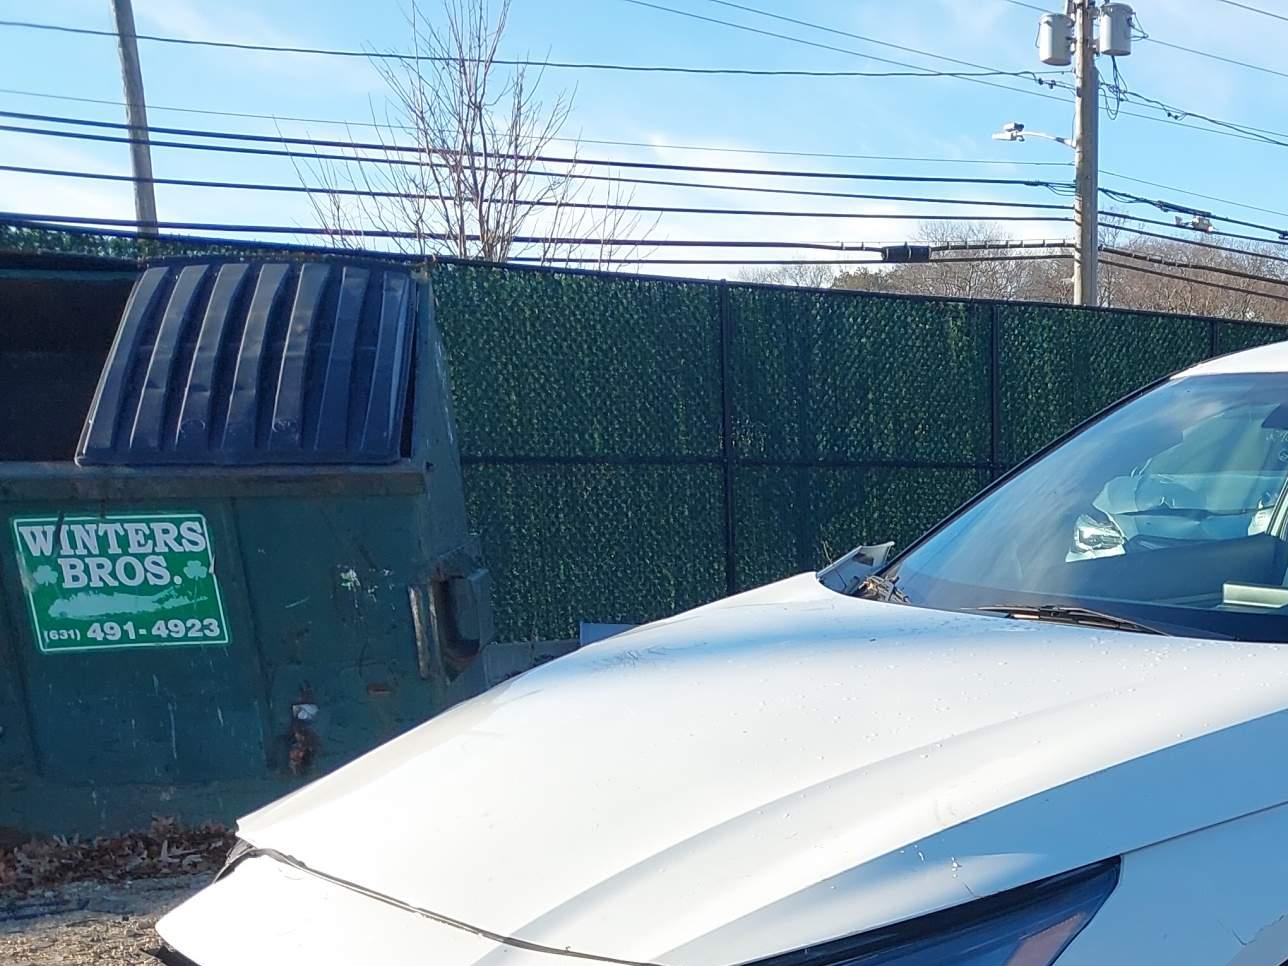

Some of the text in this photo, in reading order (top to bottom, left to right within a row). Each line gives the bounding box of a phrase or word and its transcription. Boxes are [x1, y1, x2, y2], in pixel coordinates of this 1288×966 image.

[18, 521, 207, 557] WINTERS
[58, 555, 183, 588] BROS.
[43, 618, 221, 642] (631) 491-4923
